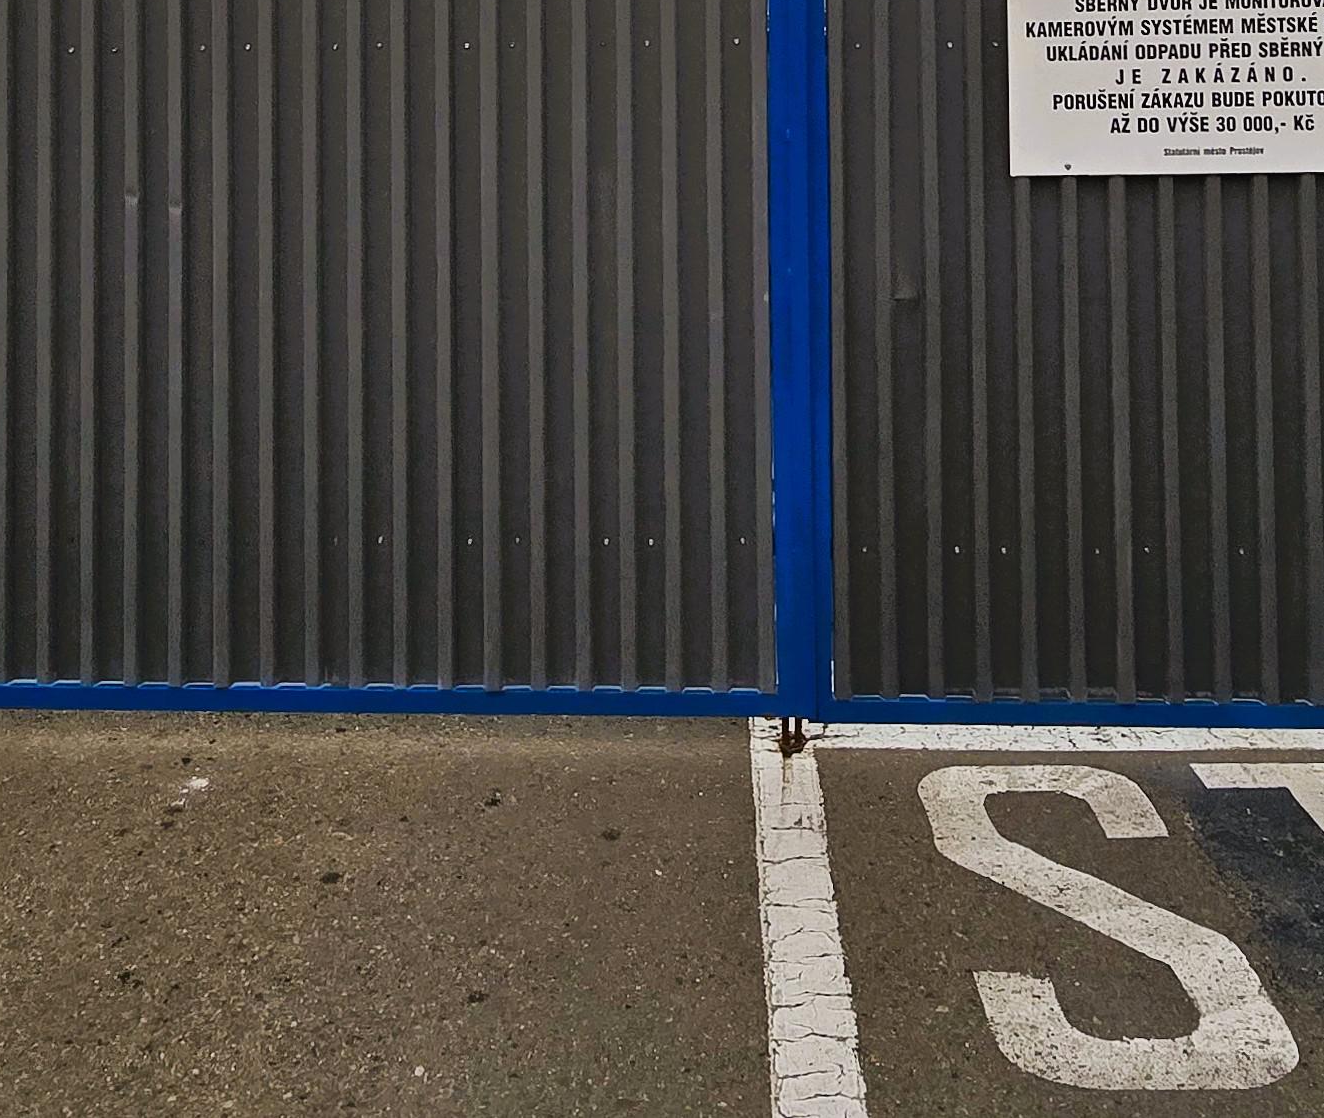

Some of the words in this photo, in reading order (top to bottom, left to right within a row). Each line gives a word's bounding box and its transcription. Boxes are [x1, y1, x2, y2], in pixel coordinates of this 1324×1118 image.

[1025, 15, 1134, 38] KAMEROVÝM
[1140, 14, 1234, 36] SYSTÉMEM
[1241, 11, 1318, 34] MĚSTSKÉ
[1046, 40, 1129, 61] UKLÁDÁNÍ
[1135, 43, 1201, 60] ODPADU
[1209, 37, 1252, 58] PŘED
[1259, 36, 1323, 58] SBĚRNÝ
[1115, 69, 1142, 84] JE
[1161, 62, 1307, 84] ZAKÁZÁNO.
[1053, 88, 1134, 110] PORUŠENÍ
[1141, 88, 1204, 109] ZÁKAZU
[1212, 91, 1255, 108] BUDE
[1110, 113, 1131, 134] AŽ
[1137, 117, 1160, 133] DO
[1167, 112, 1209, 133] VÝŠE
[1216, 116, 1236, 133] 30
[1243, 116, 1287, 134] 000,-
[1293, 114, 1315, 131] Kč
